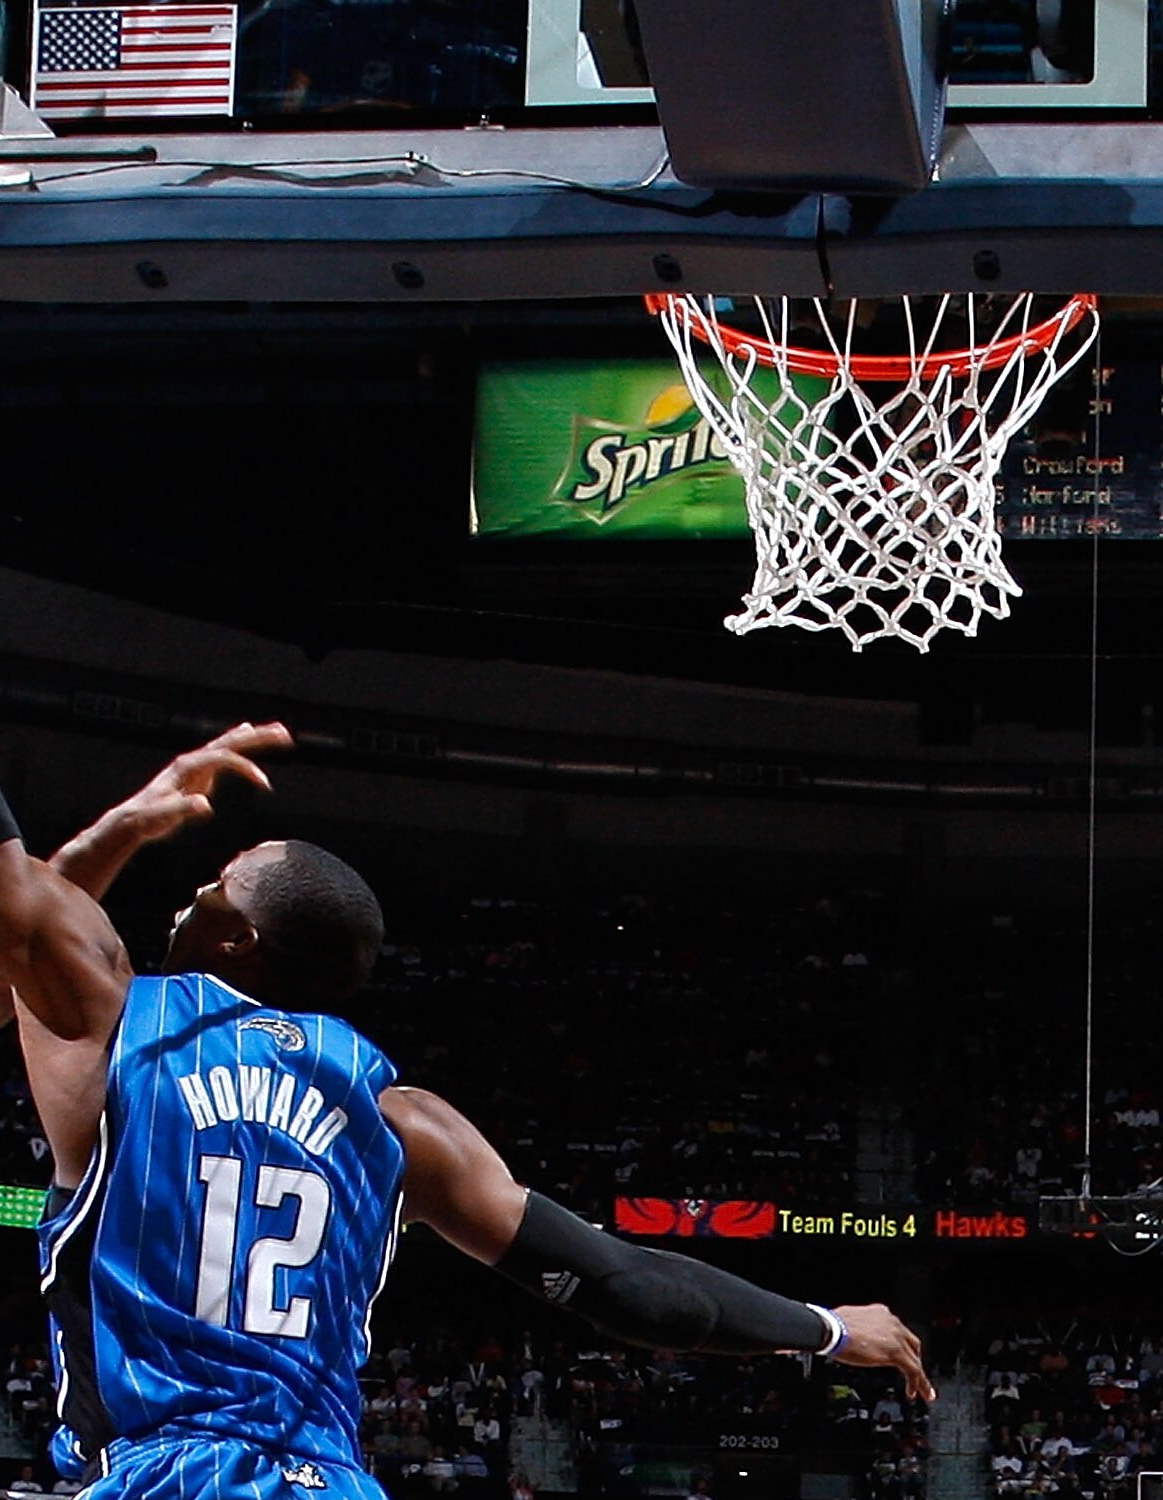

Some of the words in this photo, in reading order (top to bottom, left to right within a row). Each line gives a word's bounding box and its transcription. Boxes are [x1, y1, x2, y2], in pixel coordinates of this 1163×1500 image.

[179, 1065, 349, 1155] HOWARD
[194, 1155, 330, 1339] 12
[779, 1209, 834, 1235] Team
[841, 1212, 897, 1238] Fouls
[902, 1213, 918, 1238] 4
[936, 1210, 1027, 1238] Hawks
[719, 1434, 780, 1450] 202-203
